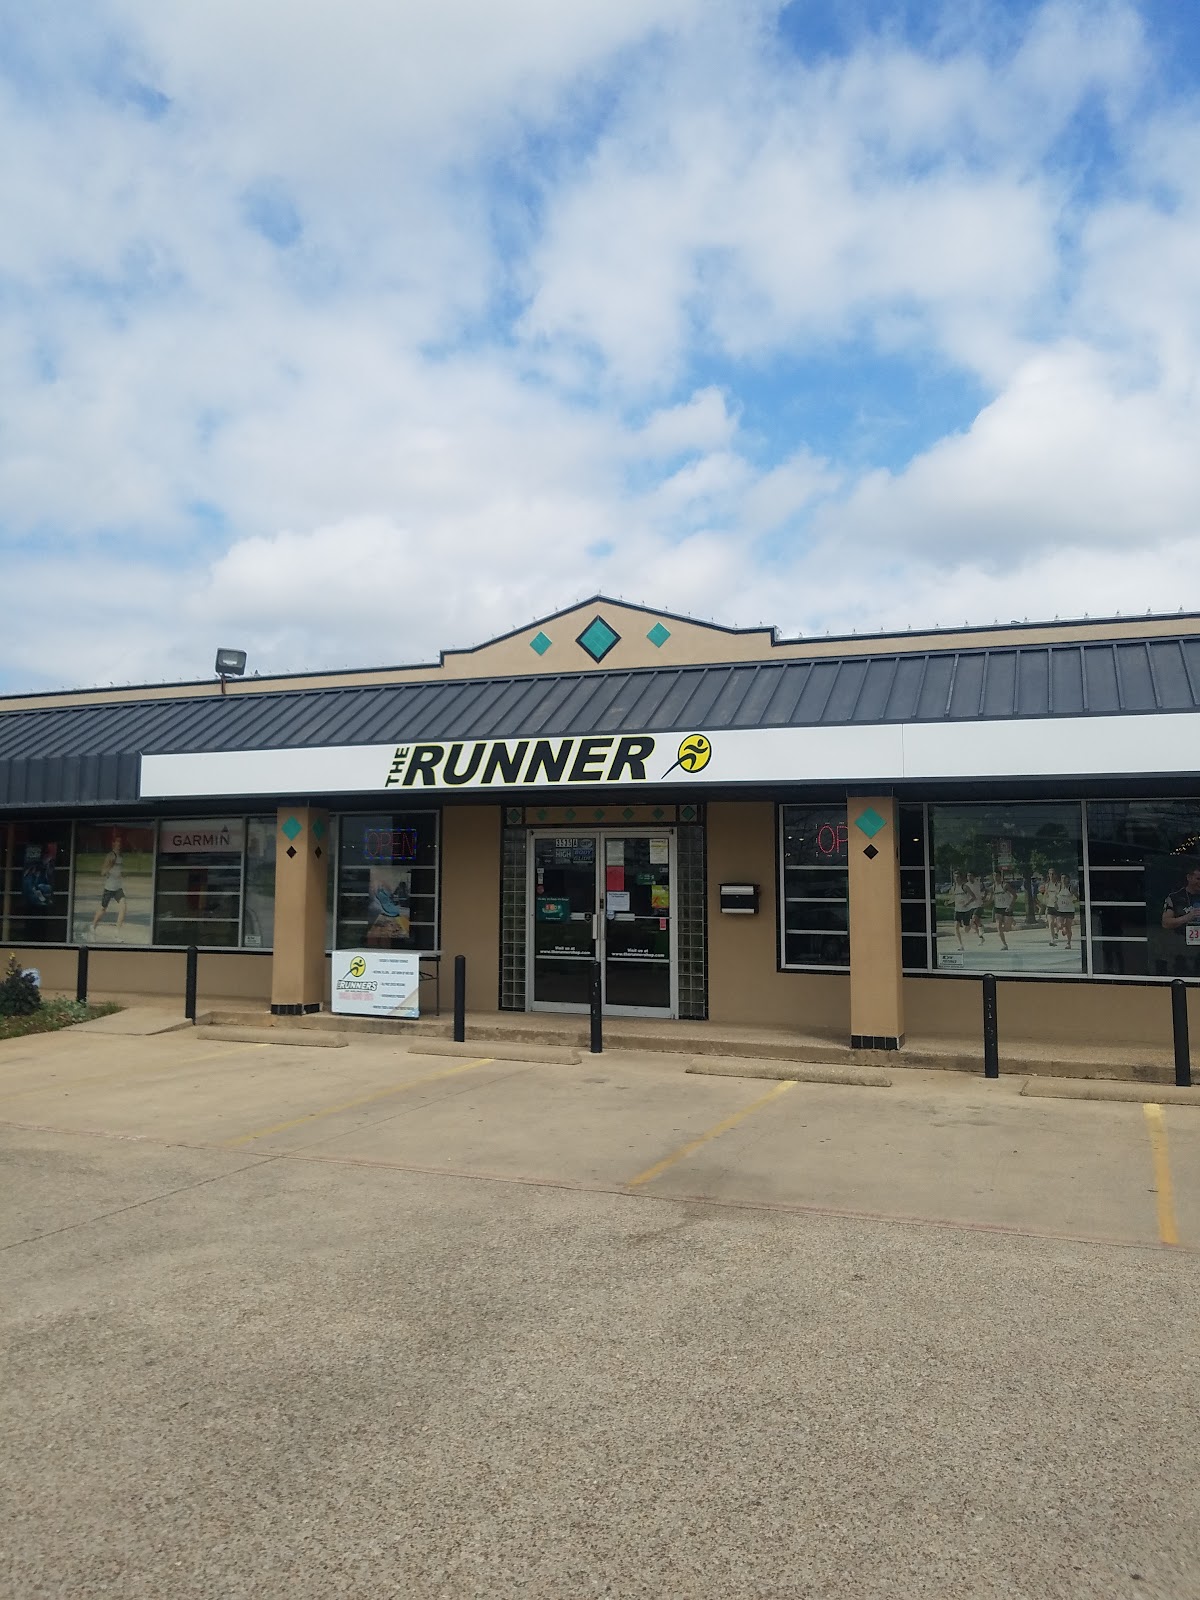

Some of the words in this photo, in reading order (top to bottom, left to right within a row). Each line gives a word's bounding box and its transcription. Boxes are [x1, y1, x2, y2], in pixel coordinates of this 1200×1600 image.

[384, 747, 410, 788] THE
[401, 736, 656, 787] RUNNER
[172, 832, 230, 847] GARMIN
[366, 832, 415, 856] OPEN
[817, 825, 848, 854] OP
[339, 980, 378, 992] RUNNERS
